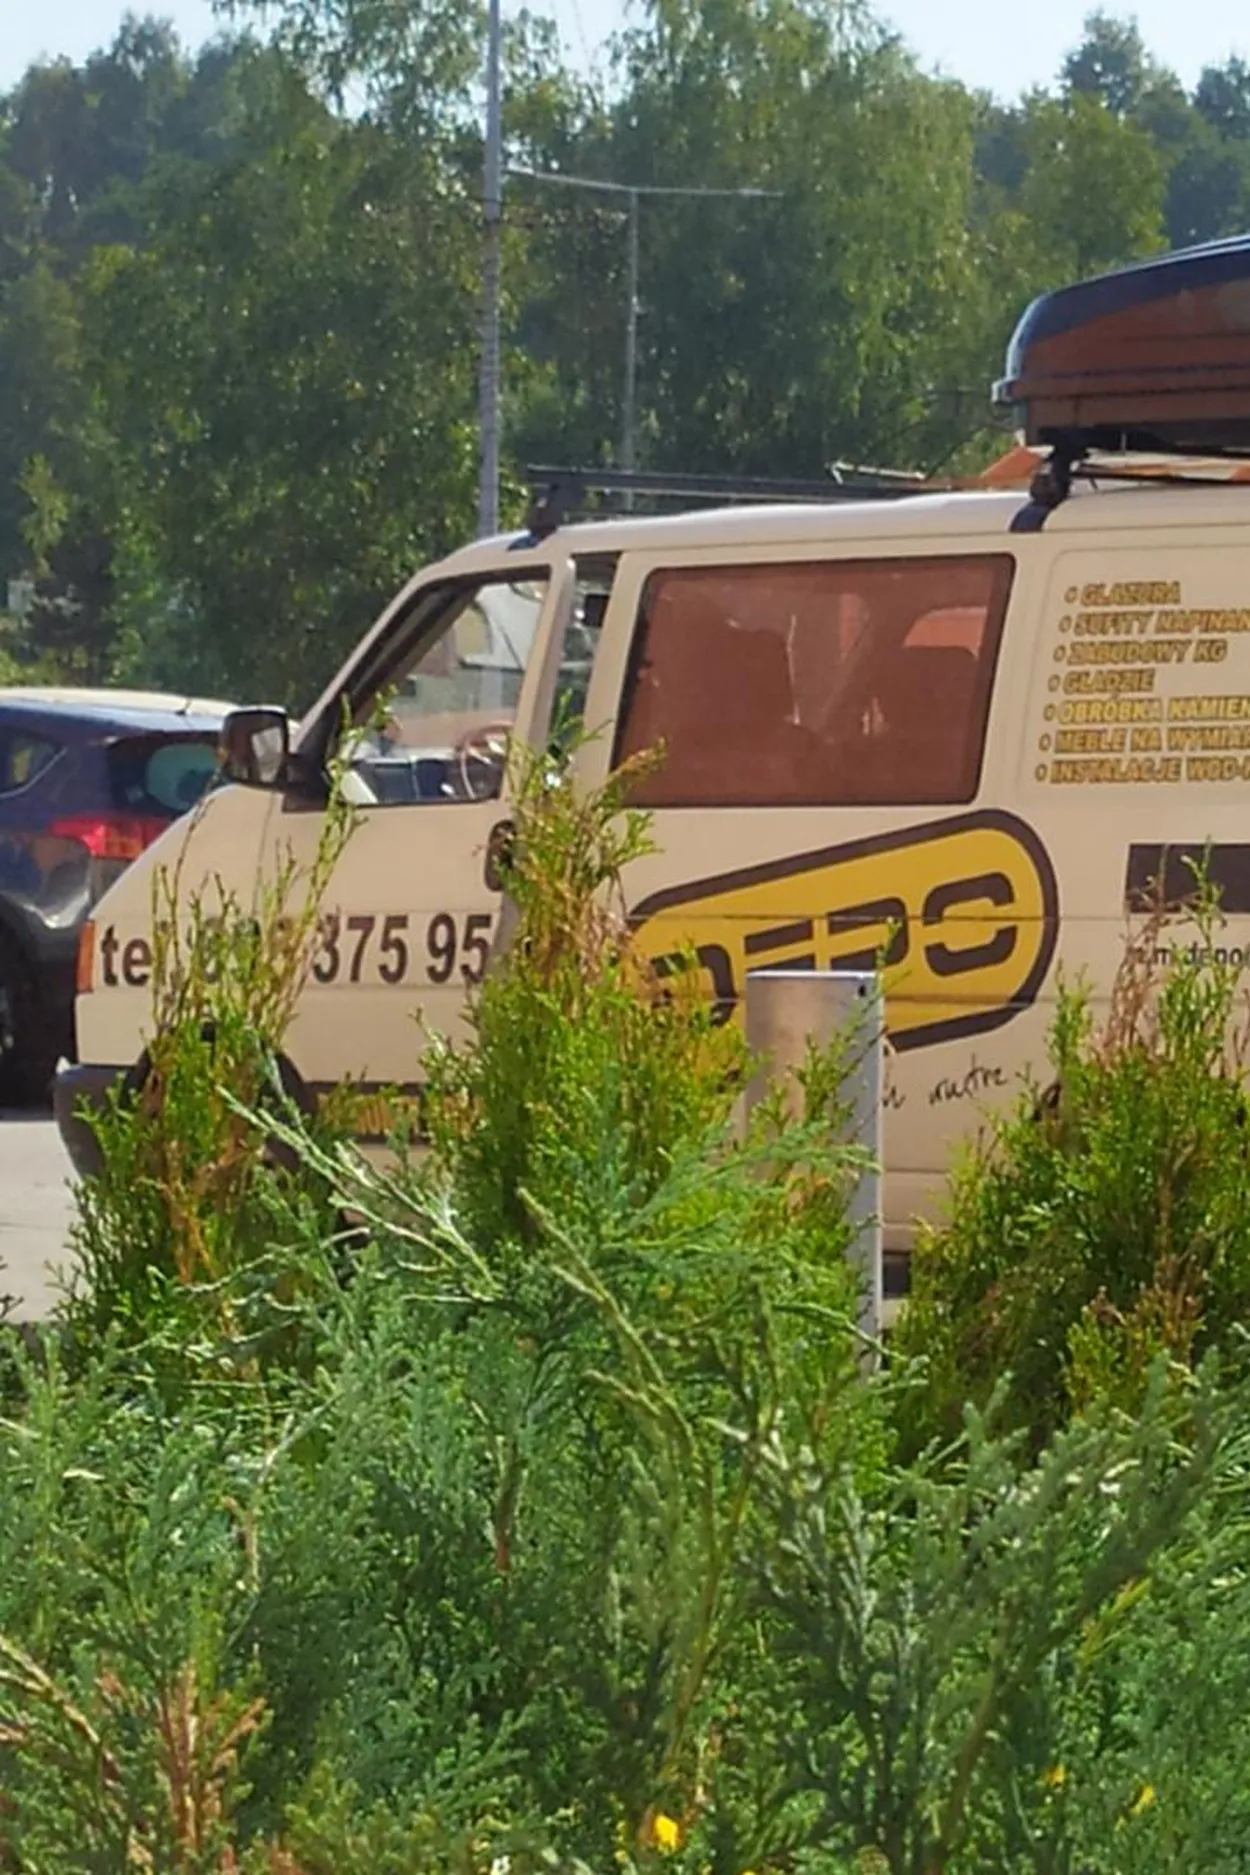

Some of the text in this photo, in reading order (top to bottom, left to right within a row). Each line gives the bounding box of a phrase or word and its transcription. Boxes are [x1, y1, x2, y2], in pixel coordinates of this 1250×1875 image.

[1193, 639, 1228, 663] KG
[1055, 728, 1127, 753] MEBLE
[426, 912, 492, 984] 95
